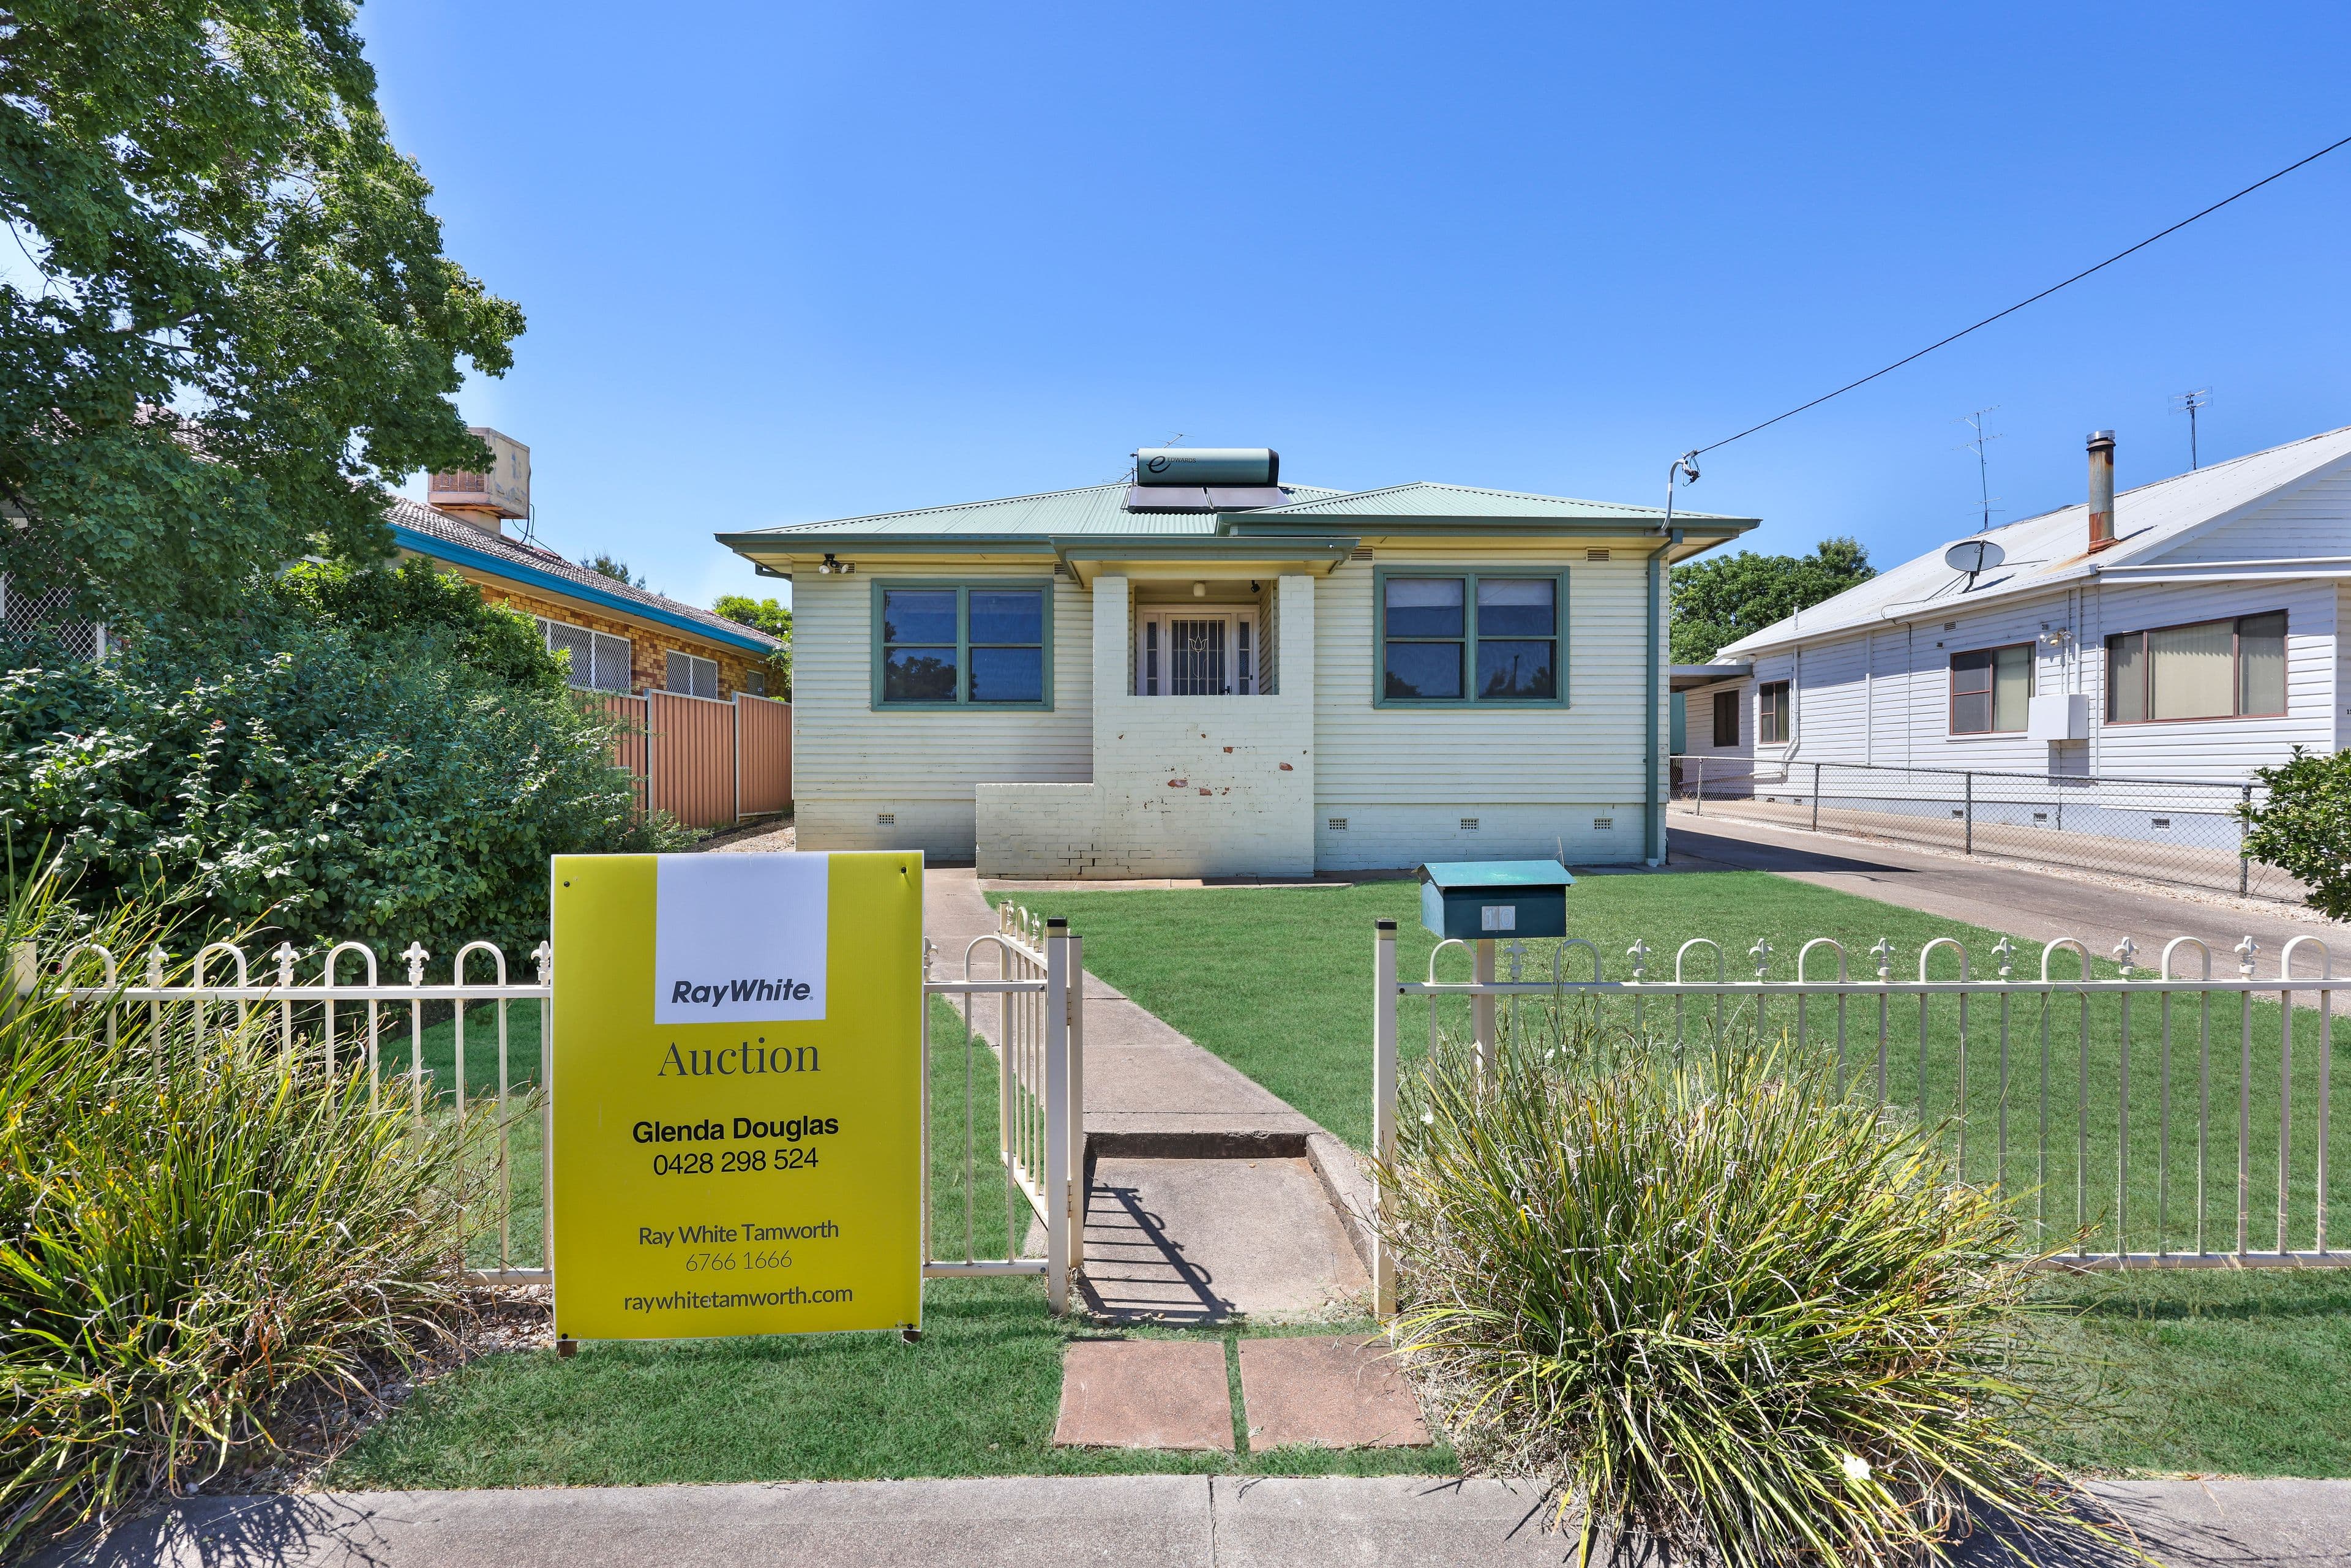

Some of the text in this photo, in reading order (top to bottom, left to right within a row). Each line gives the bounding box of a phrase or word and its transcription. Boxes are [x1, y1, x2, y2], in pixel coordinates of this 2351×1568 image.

[1485, 909, 1513, 928] 10
[657, 1037, 821, 1076] Auction
[632, 1115, 839, 1144] Glenda Douglas
[653, 1147, 819, 1176] 0428 298 524
[639, 1220, 839, 1248] Ray White Tamworth
[686, 1250, 792, 1272] 6766 1666
[624, 1286, 853, 1315] raywhitetamworth.com
